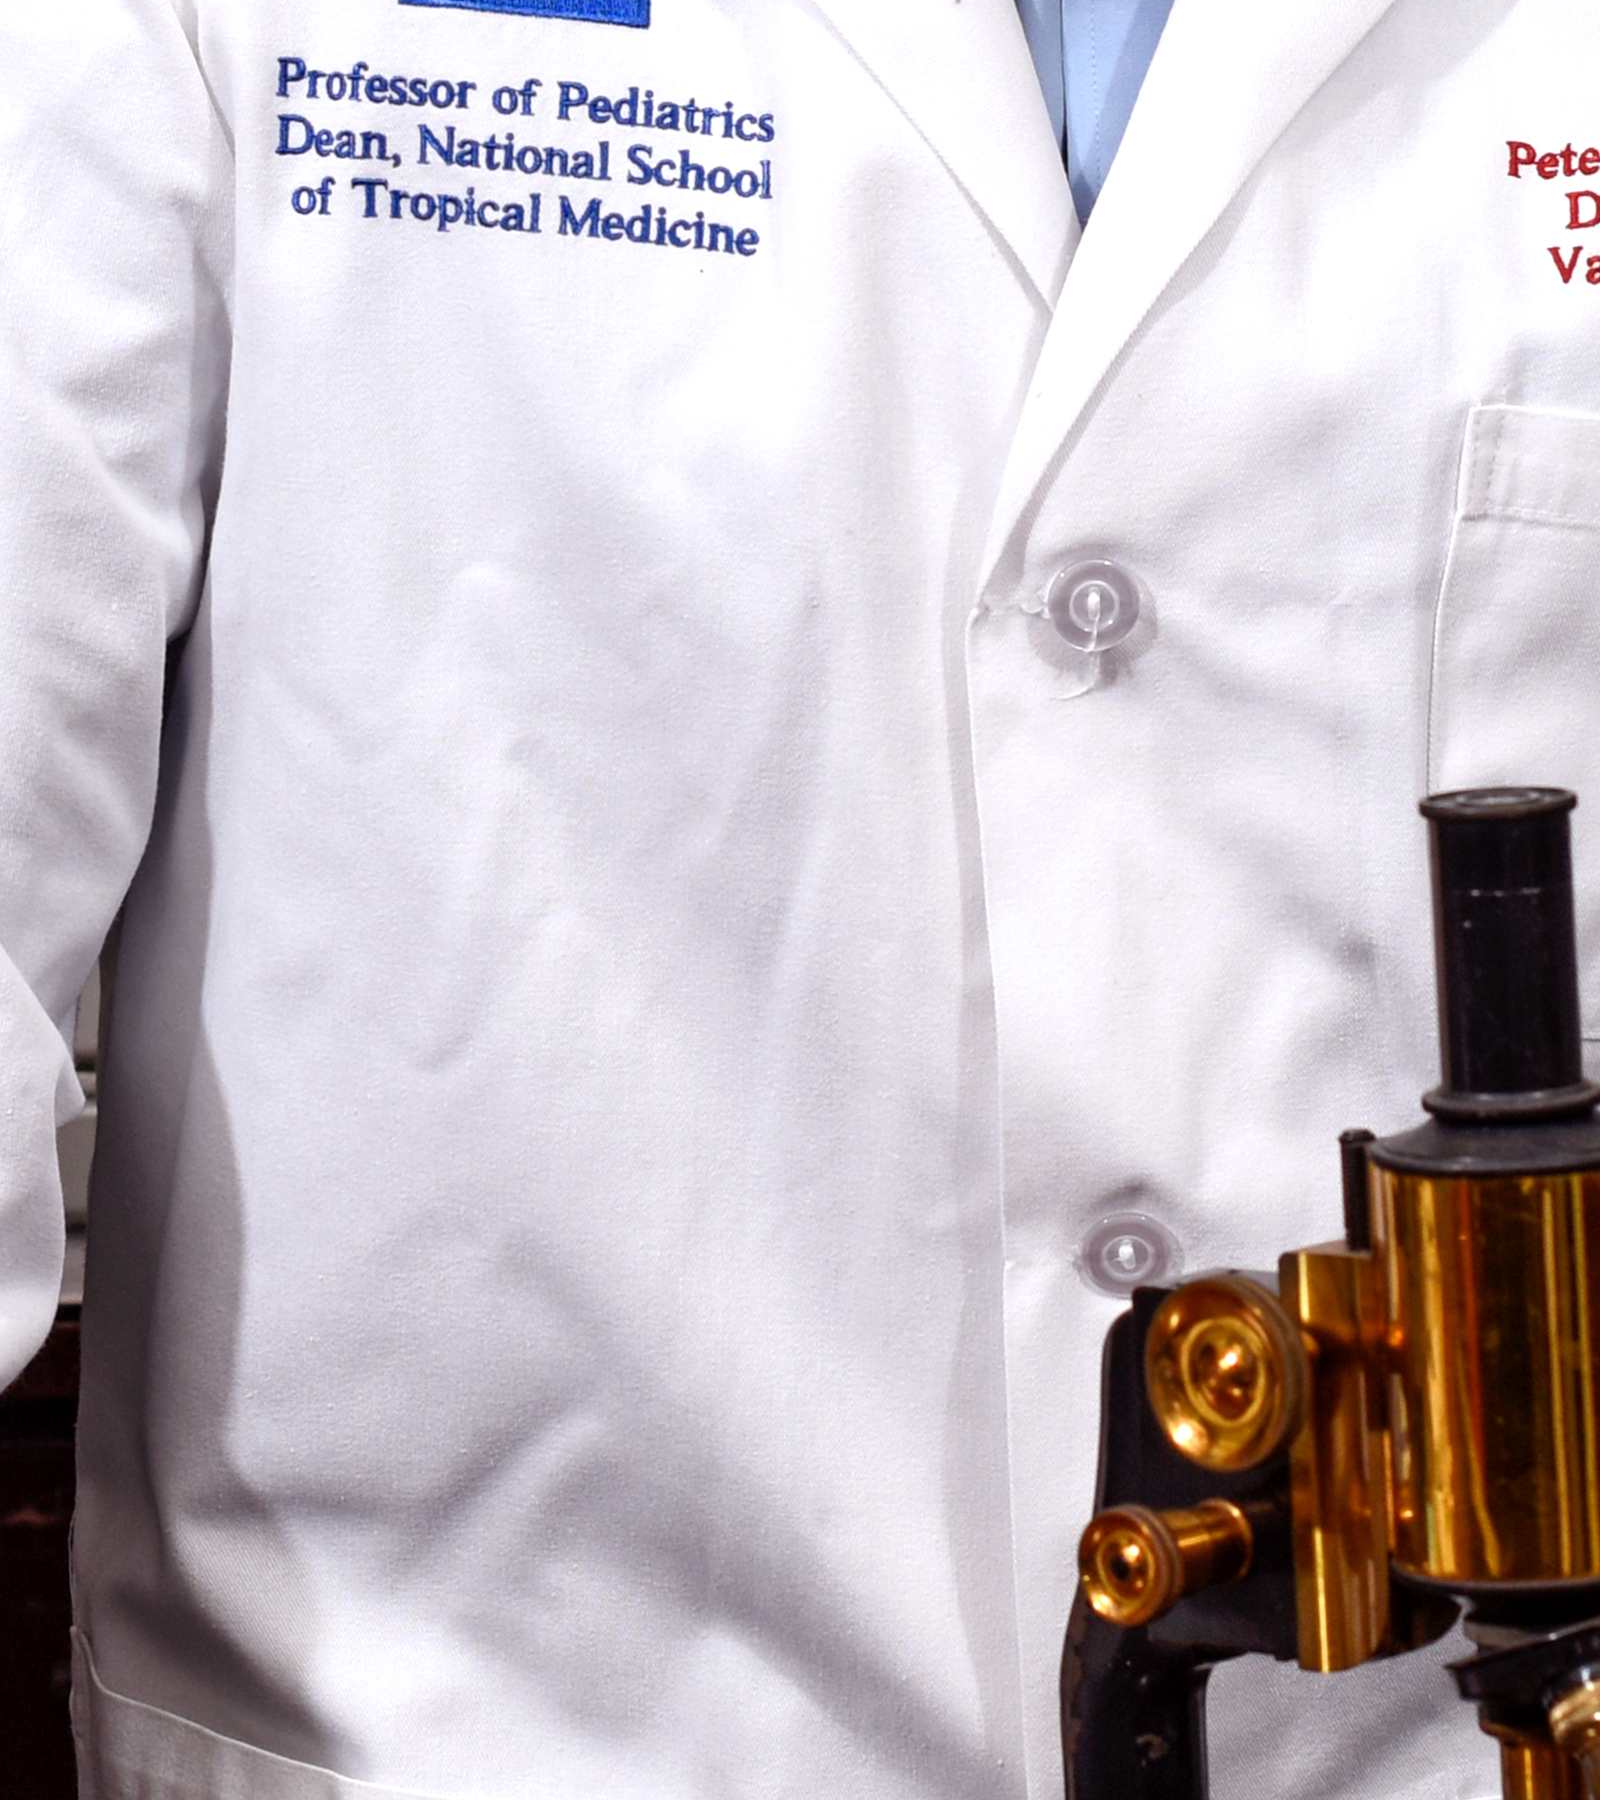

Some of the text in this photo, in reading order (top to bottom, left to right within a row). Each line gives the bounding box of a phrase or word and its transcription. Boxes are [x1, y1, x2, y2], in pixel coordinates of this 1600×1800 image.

[275, 57, 776, 143] Professor of Pediatrics
[274, 114, 773, 200] Dean, National School
[291, 177, 760, 257] of Tropical Medicine
